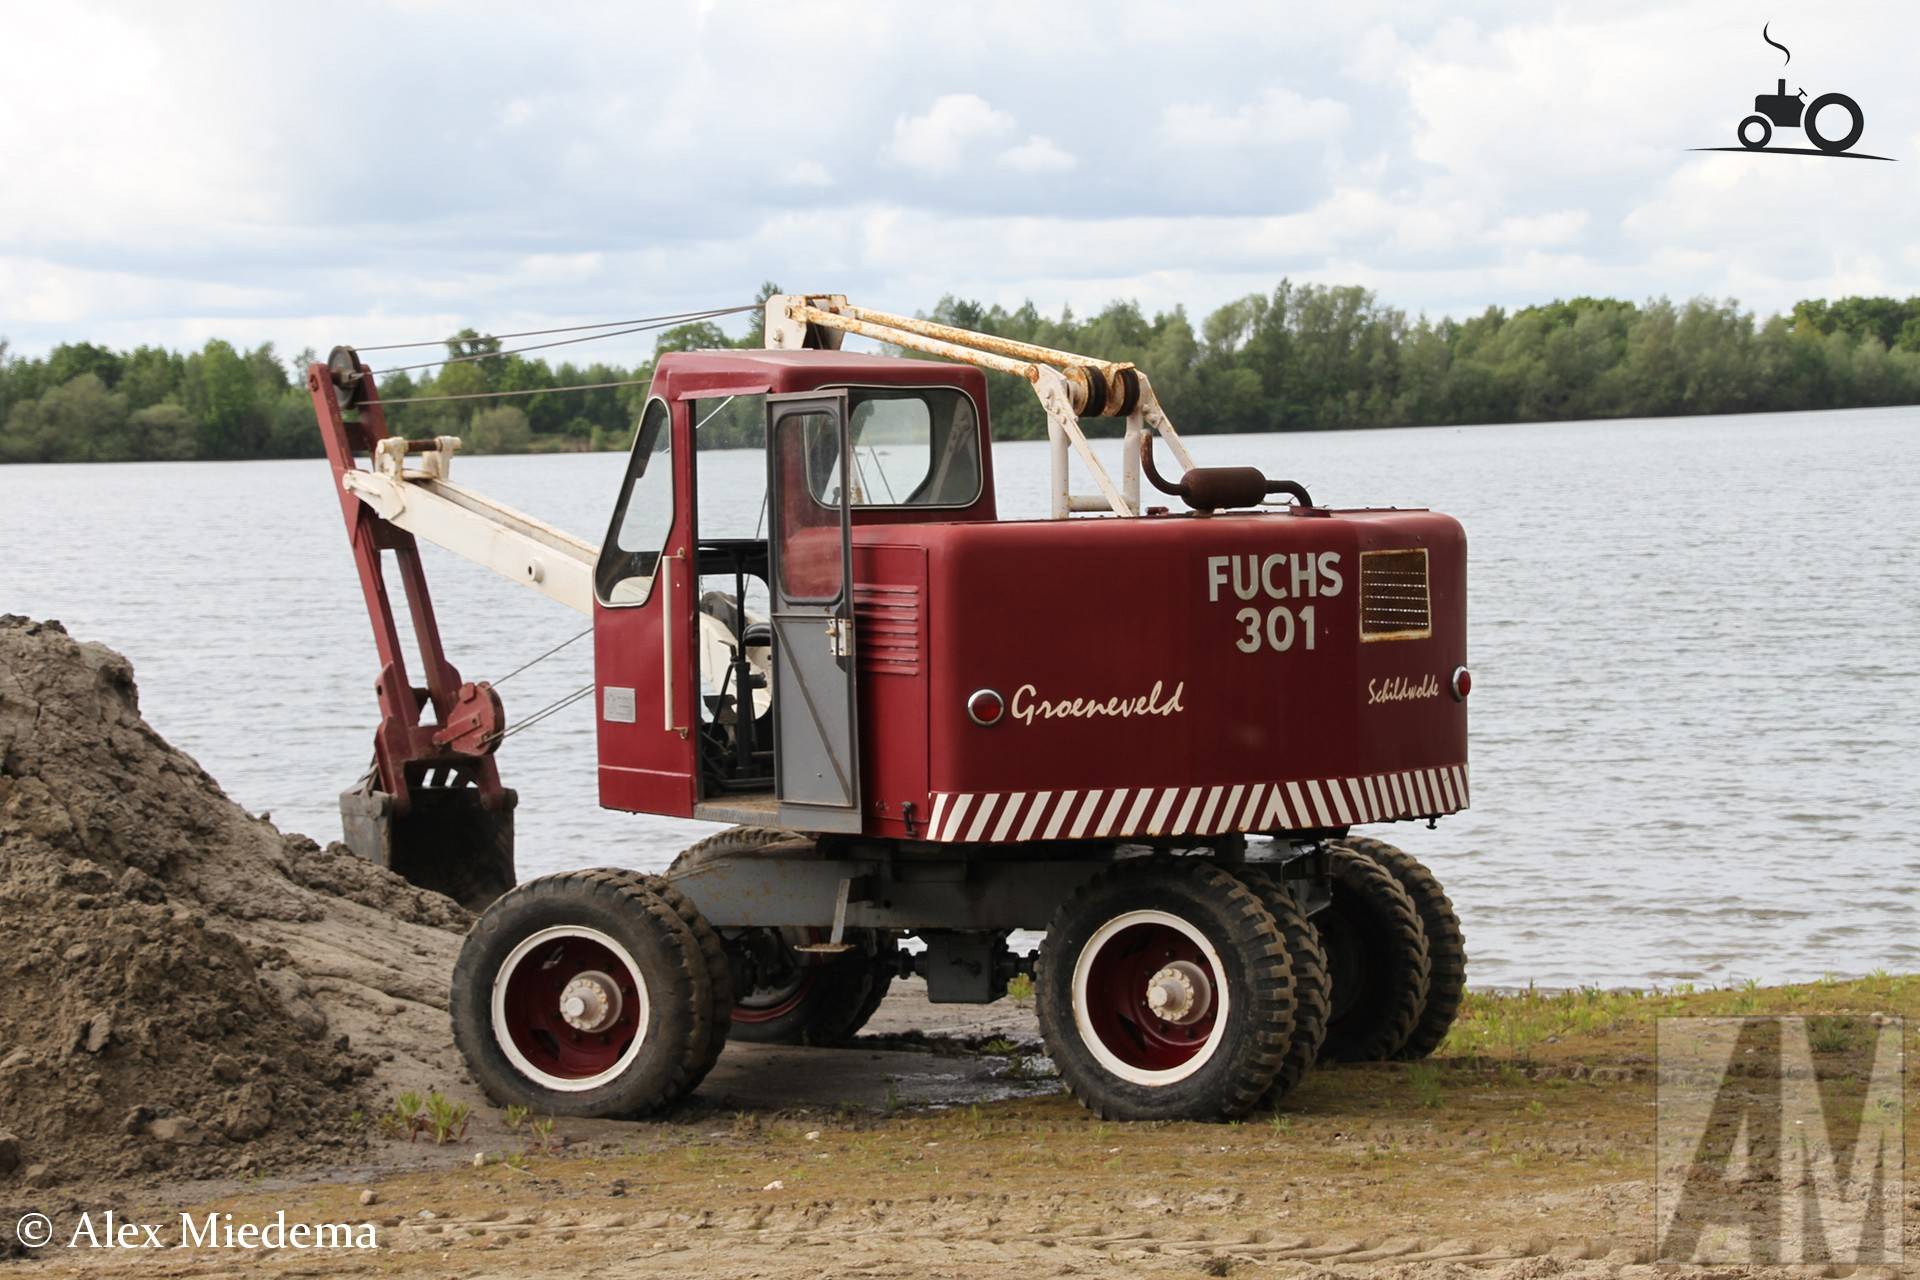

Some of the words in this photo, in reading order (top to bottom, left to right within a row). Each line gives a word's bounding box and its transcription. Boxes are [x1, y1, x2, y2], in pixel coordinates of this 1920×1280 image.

[1207, 551, 1344, 602] FUCHS
[1235, 605, 1315, 653] 301
[1011, 680, 1184, 726] Groeneveld
[1368, 674, 1439, 704] Schildwolde
